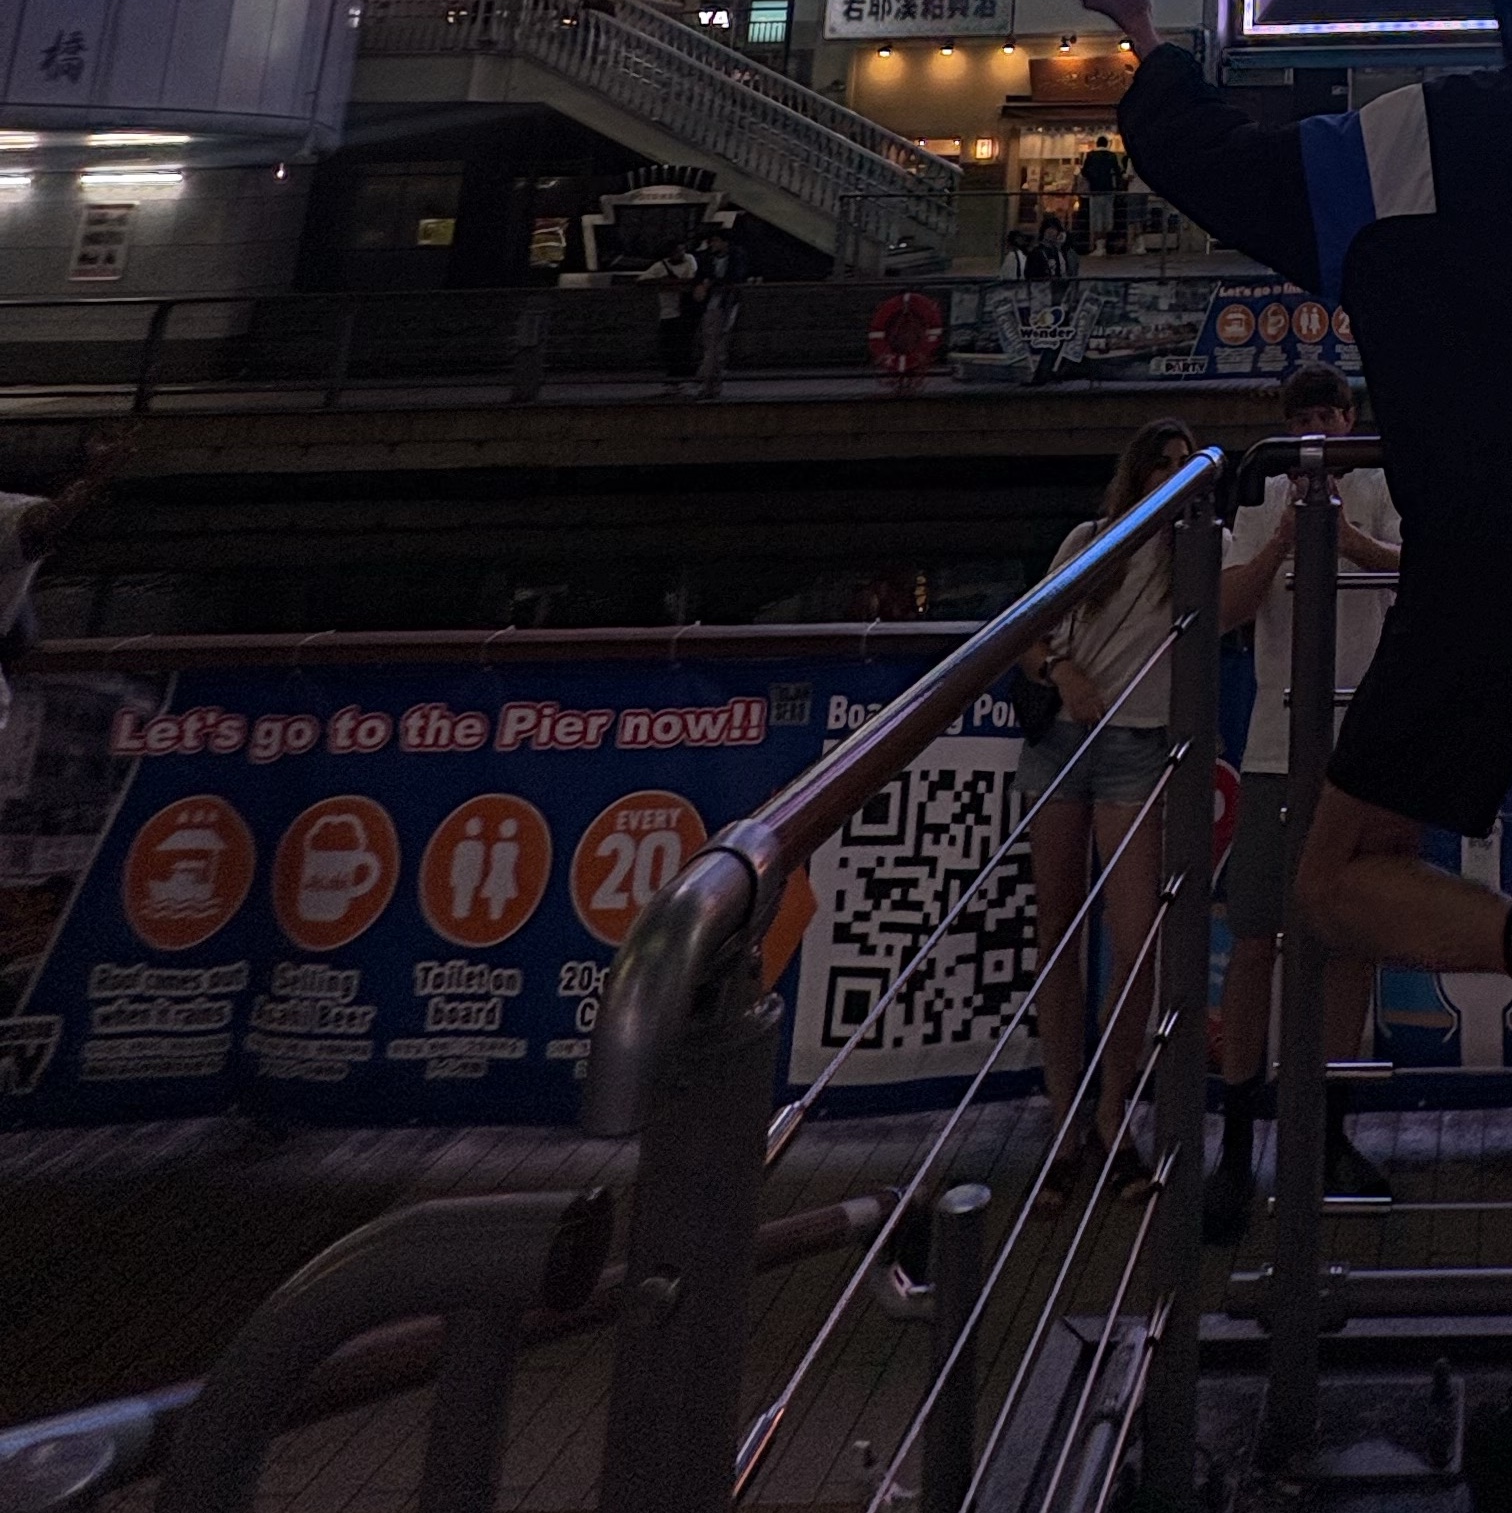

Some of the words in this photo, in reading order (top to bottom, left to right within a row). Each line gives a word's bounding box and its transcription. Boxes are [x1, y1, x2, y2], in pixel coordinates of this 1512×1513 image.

[112, 707, 246, 756] Let's
[251, 714, 320, 765] go
[328, 703, 393, 752] to
[401, 701, 486, 752] the
[498, 700, 614, 751] Pier
[617, 697, 769, 748] now!!
[616, 808, 682, 830] EVERY
